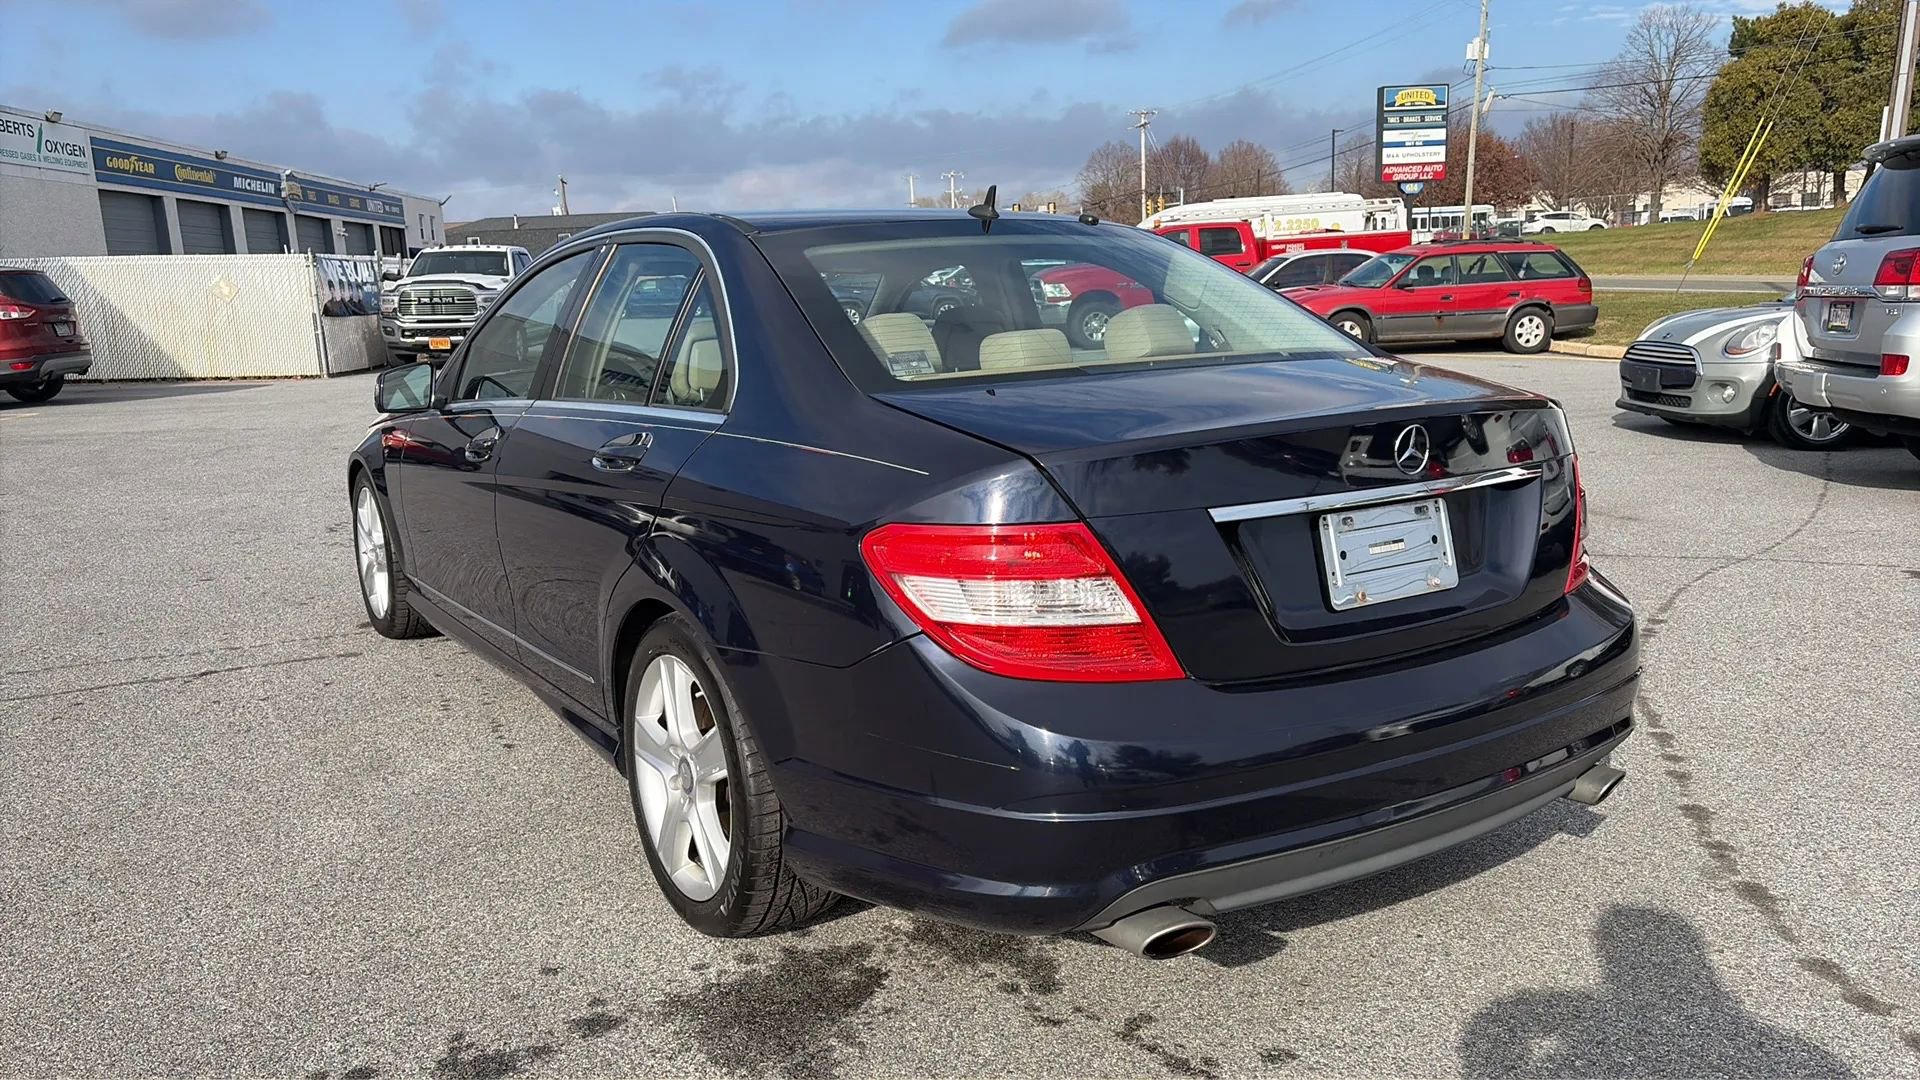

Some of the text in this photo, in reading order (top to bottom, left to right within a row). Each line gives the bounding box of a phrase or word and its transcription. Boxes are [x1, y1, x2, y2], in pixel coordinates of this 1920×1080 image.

[1401, 90, 1430, 101] UNITED
[45, 139, 86, 158] OXYGEN
[1401, 151, 1441, 159] UPHOLSTERY
[106, 155, 155, 174] GOODYEAR
[1383, 164, 1443, 174] ADVANCED AUTO
[175, 164, 214, 184] Continental
[1392, 172, 1434, 181] GROUP LLC
[233, 177, 275, 194] MICHELIN
[321, 258, 346, 283] WE
